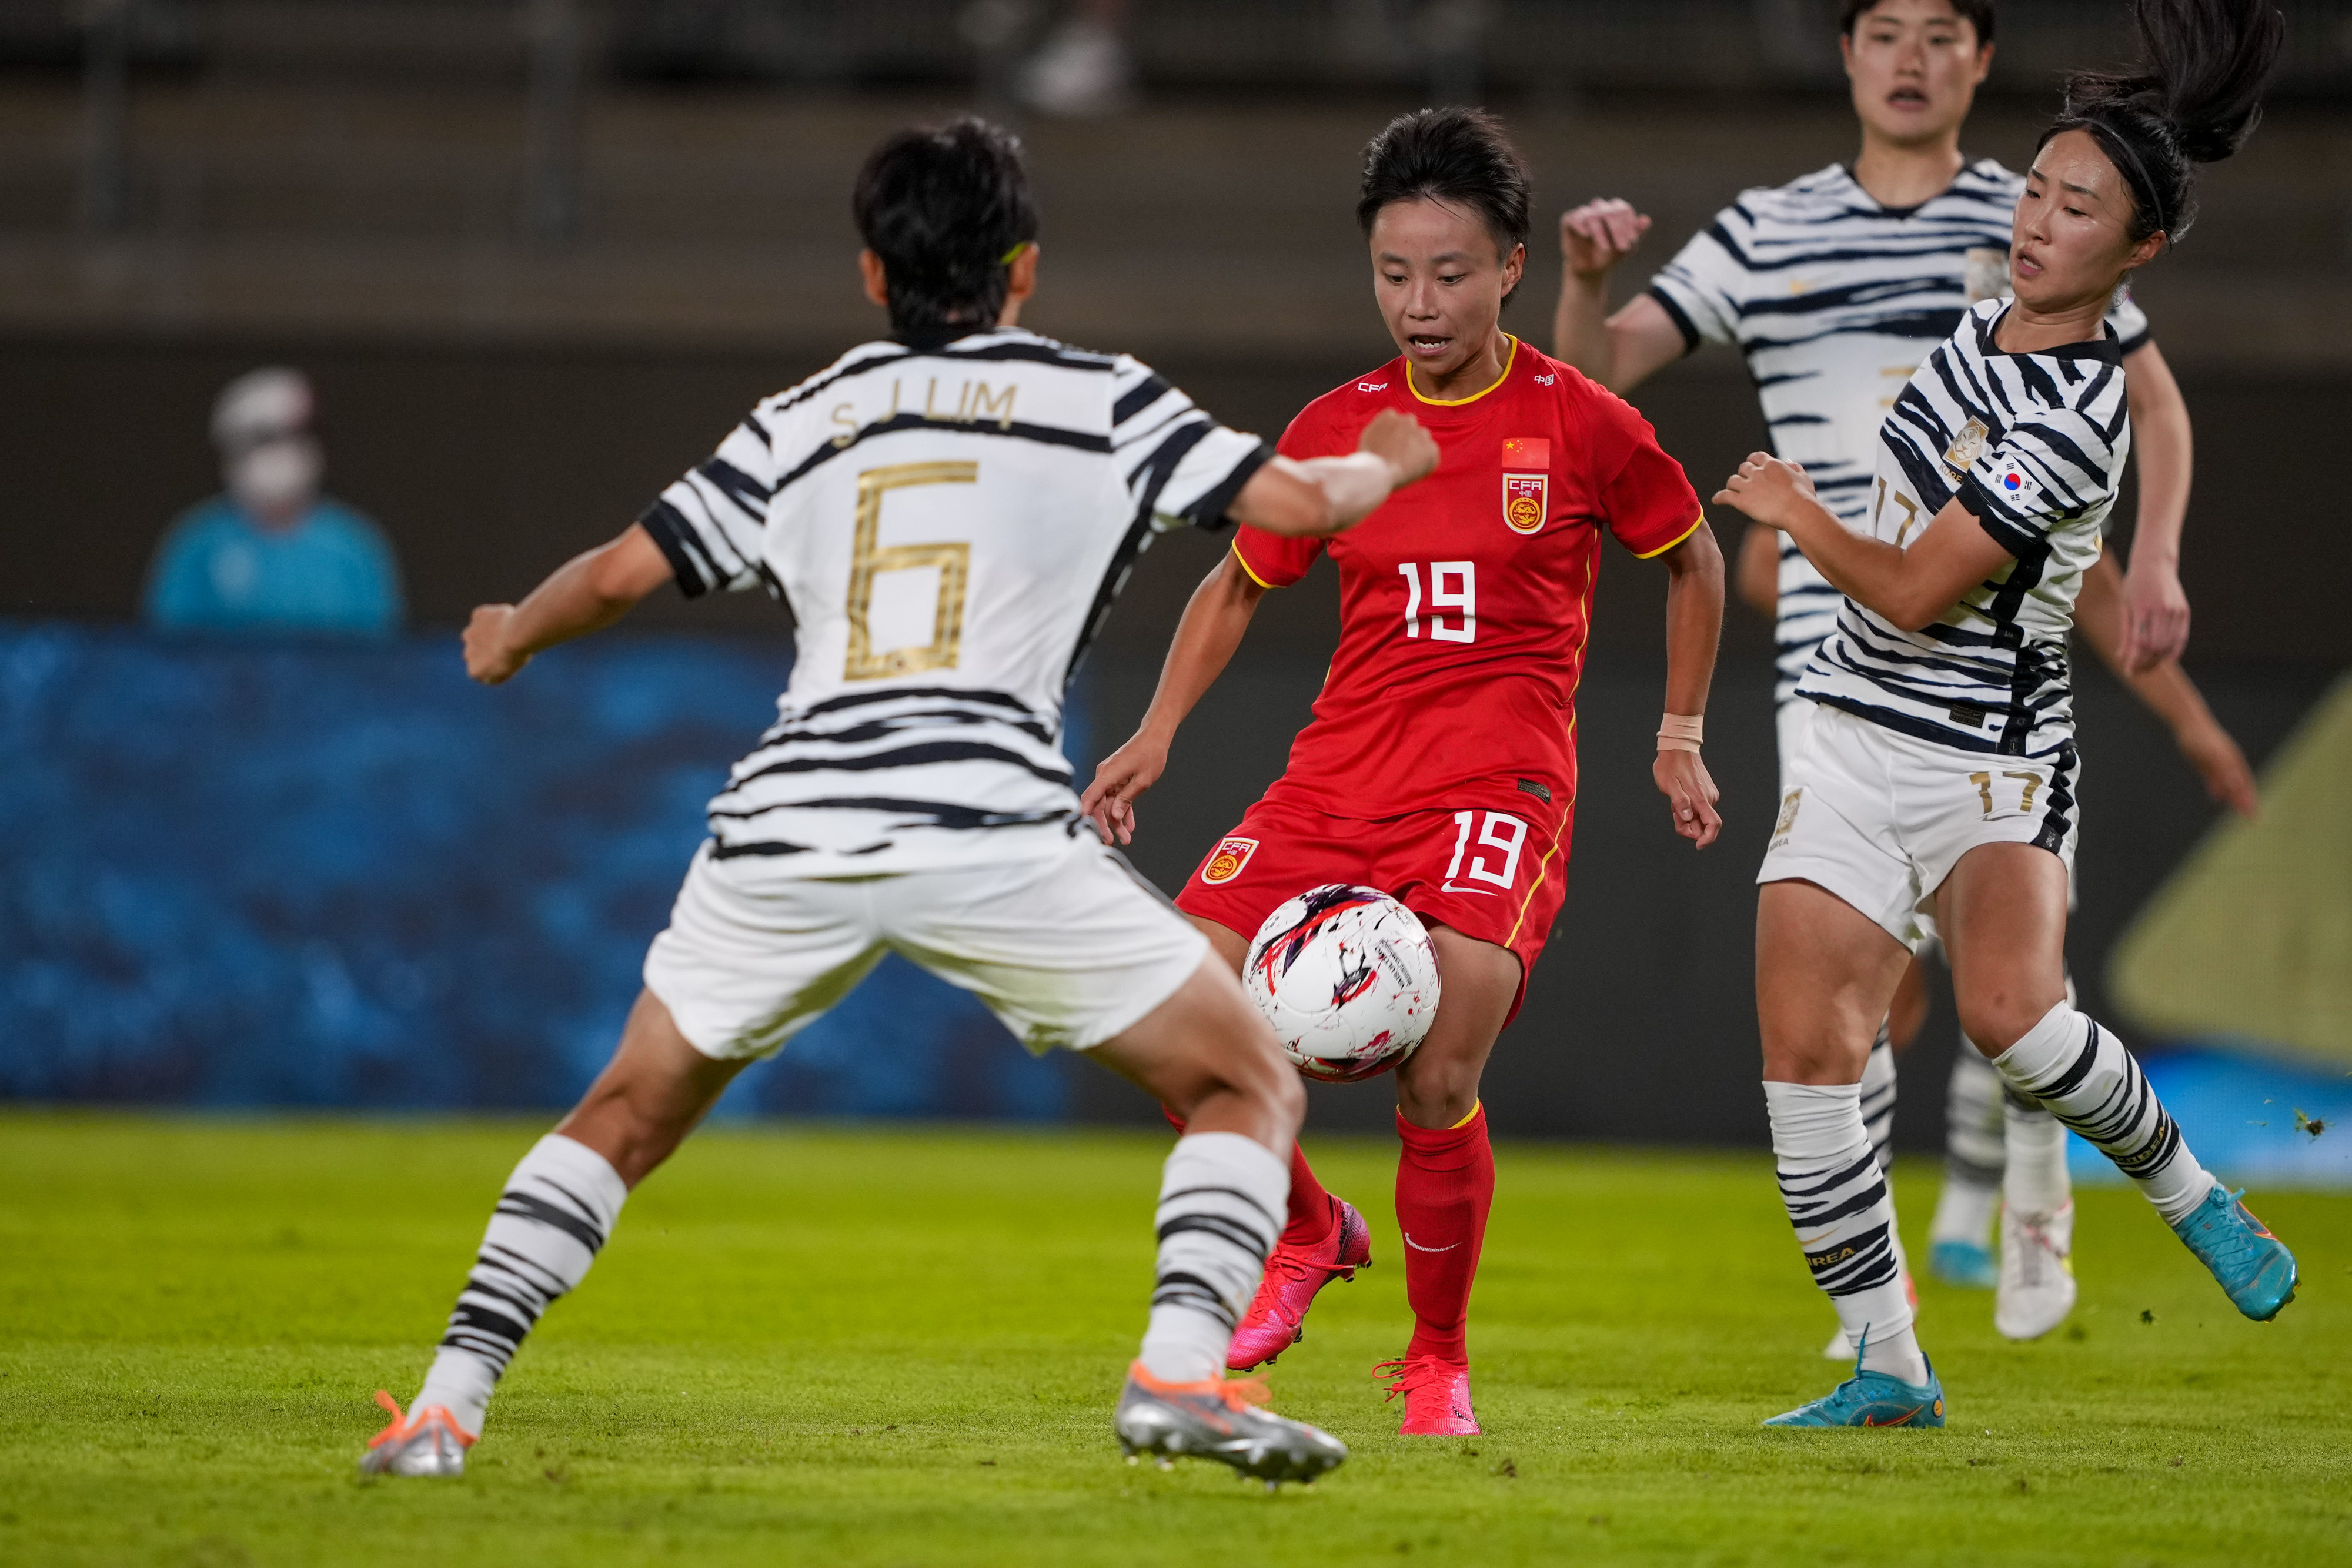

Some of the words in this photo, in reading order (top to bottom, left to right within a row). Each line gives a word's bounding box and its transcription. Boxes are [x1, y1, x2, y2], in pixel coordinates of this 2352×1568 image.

[1358, 382, 1388, 393] CFA
[1534, 375, 1555, 386] 中国
[831, 403, 857, 448] S
[877, 378, 901, 424] J
[923, 377, 1017, 431] LIM
[1509, 480, 1542, 491] CFA
[1939, 462, 1964, 486] KORE
[1875, 475, 1920, 548] 17
[843, 460, 978, 682] 6
[1398, 561, 1476, 644] 19
[1969, 771, 2044, 814] 17
[1222, 842, 1251, 853] CFA
[1444, 810, 1528, 890] 19
[1807, 1247, 1856, 1266] REA
